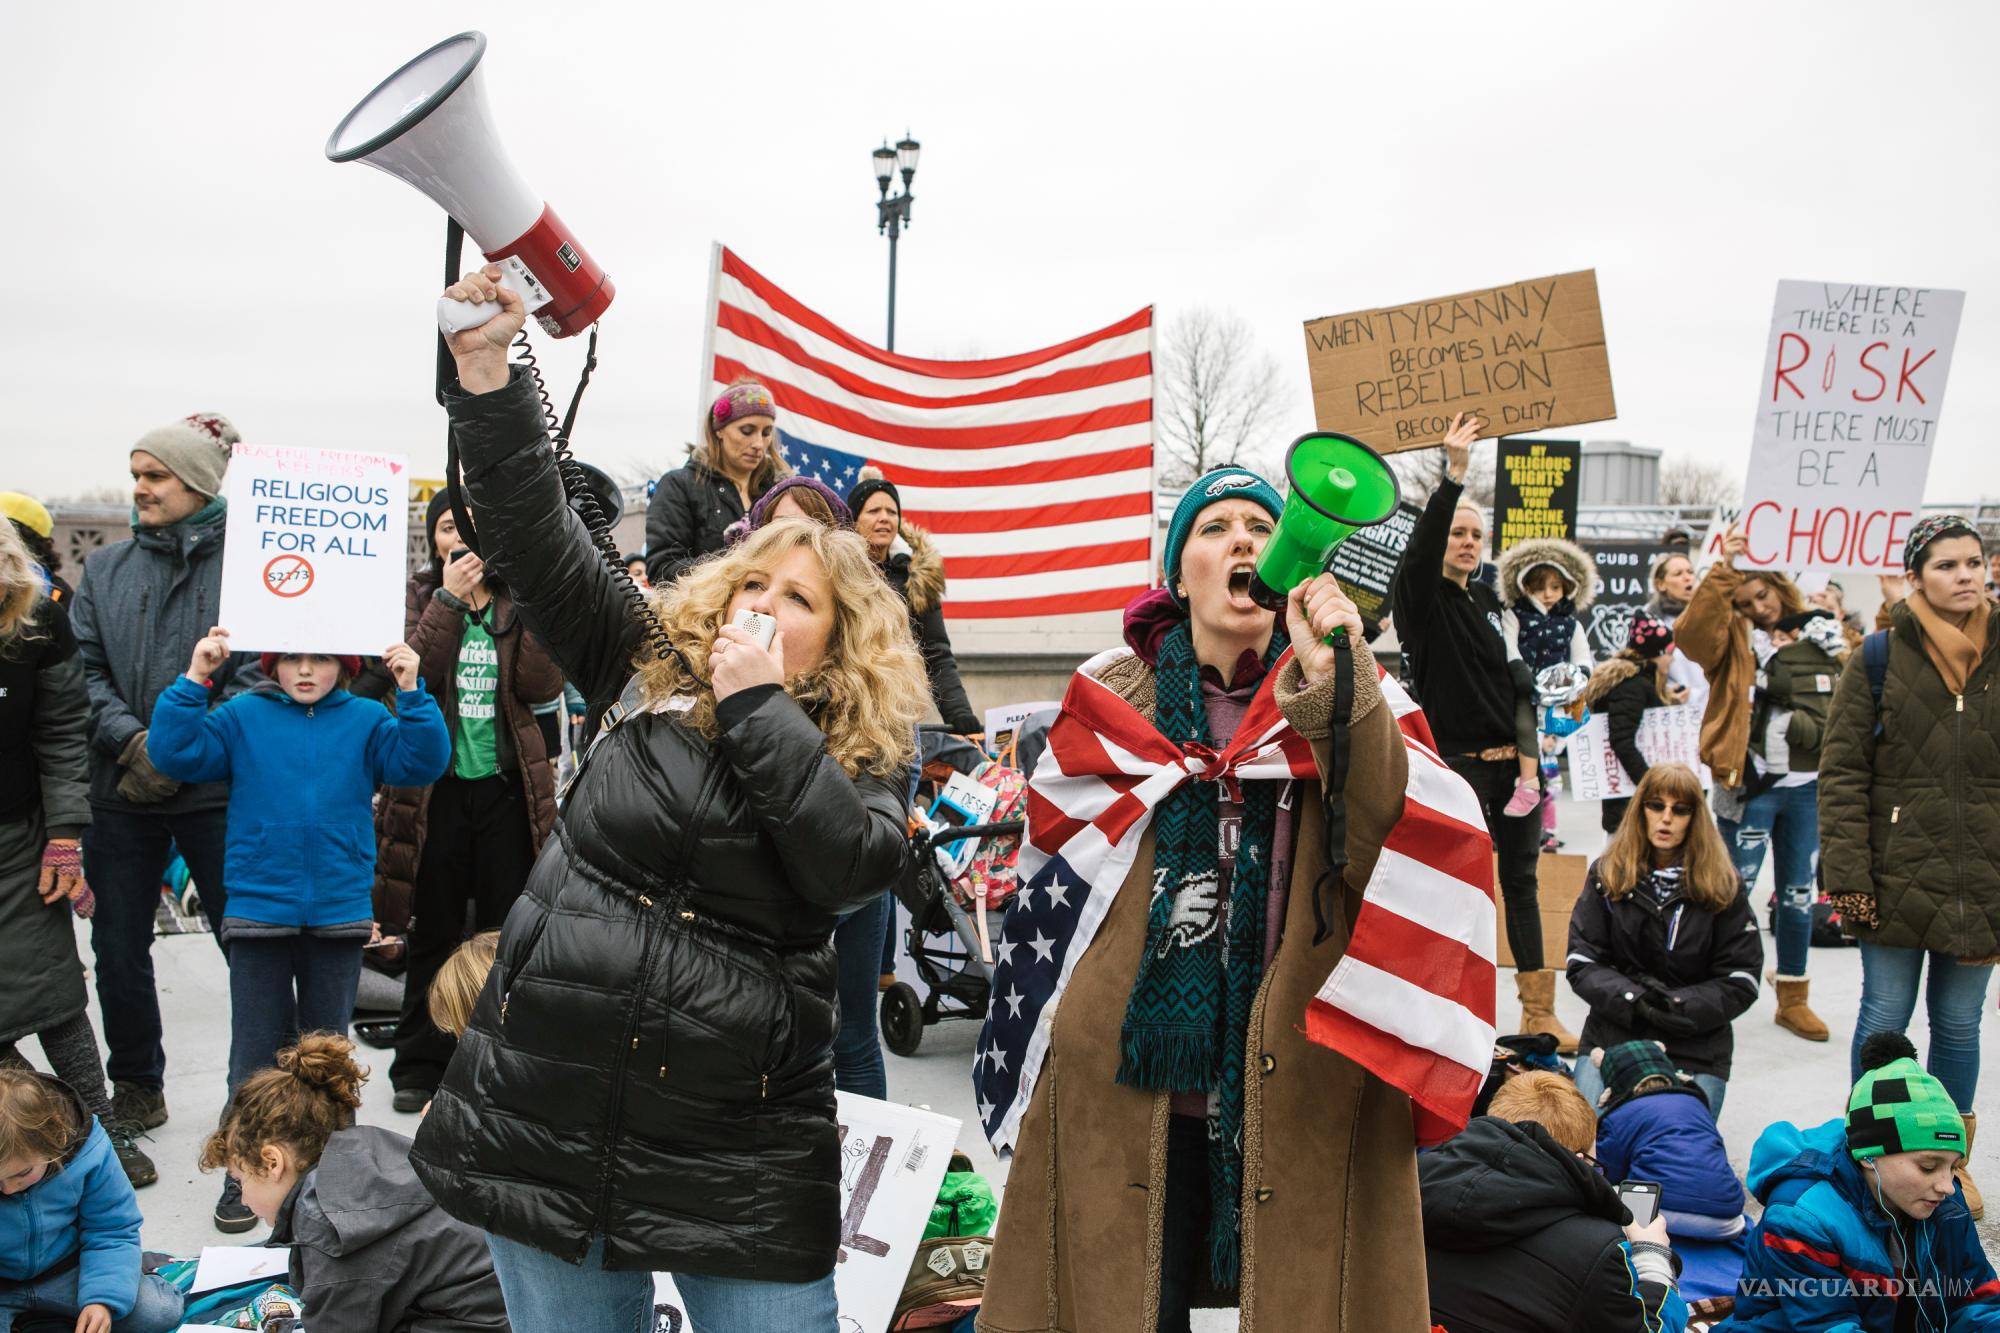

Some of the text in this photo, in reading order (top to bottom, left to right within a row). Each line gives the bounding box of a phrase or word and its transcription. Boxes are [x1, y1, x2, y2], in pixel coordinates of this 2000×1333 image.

[1824, 283, 1930, 318] WHERE
[1308, 281, 1557, 351] WHEN TYRANNY
[1794, 310, 1916, 337] THERE IS A
[1389, 327, 1543, 374] BECOMES LAW
[1356, 353, 1552, 416] REBELLION
[1502, 396, 1556, 425] DUTY
[1772, 411, 1934, 443] THERE MUST
[235, 444, 387, 469] PEACEFUL FREEDOM
[1531, 445, 1547, 456] MY
[276, 459, 365, 478] KEEPERS
[1505, 456, 1571, 471] RELIGIOUS
[1797, 449, 1880, 487] BE A
[1511, 470, 1564, 486] RIGHTS
[252, 478, 389, 506] RELIGIOUS
[1520, 486, 1554, 497] TRUMP
[1523, 497, 1549, 508] YOUR
[256, 505, 388, 531] FREEDOM
[1507, 508, 1564, 523] VACCINE
[1502, 522, 1568, 538] INDUSTRY
[1745, 500, 1912, 568] CHOICE
[261, 531, 377, 557] FOR ALL
[1596, 552, 1639, 566] CUBS
[267, 570, 310, 582] S2173
[466, 640, 488, 650] MY
[462, 666, 487, 678] MY
[461, 693, 484, 705] MY
[1006, 712, 1031, 723] PLEA
